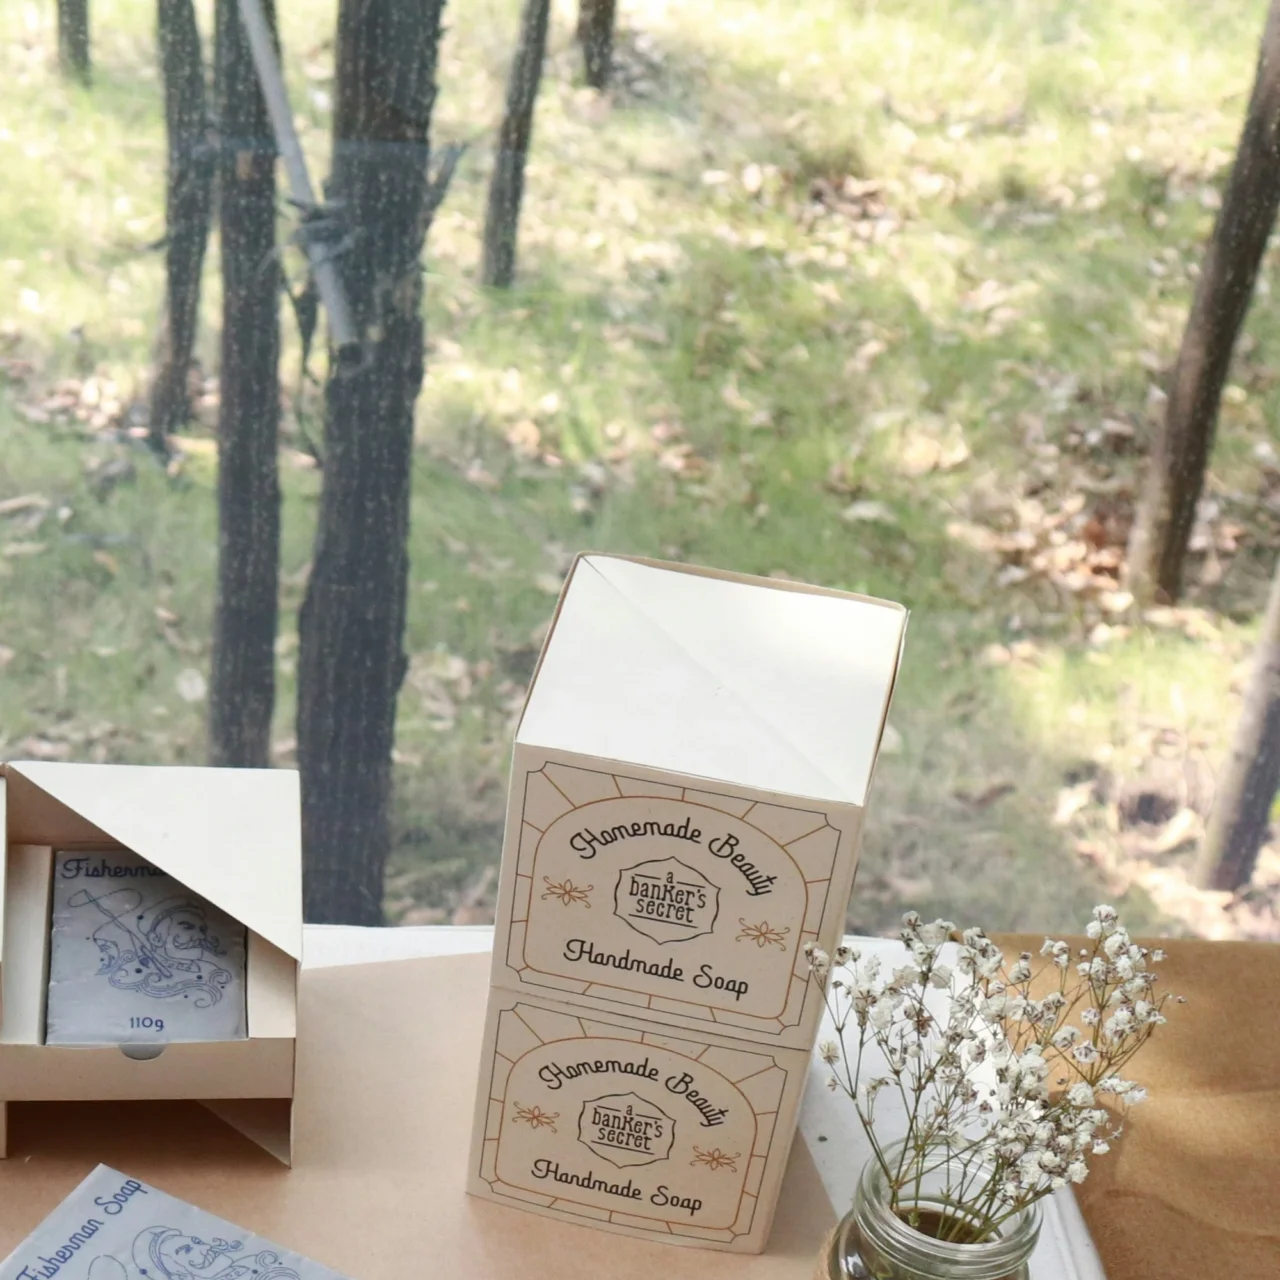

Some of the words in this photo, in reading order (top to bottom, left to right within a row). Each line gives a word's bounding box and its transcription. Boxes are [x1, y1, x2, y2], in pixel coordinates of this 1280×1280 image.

[61, 857, 167, 879] Fisherma
[569, 817, 703, 860] Homemade
[708, 833, 778, 897] Beauty
[666, 871, 674, 884] a
[635, 898, 695, 923] secret
[562, 938, 685, 982] Handmade
[692, 964, 749, 1001] Soap
[129, 1016, 165, 1033] 110g
[538, 1057, 659, 1090] Homemade
[665, 1072, 730, 1127] Beauty
[626, 1105, 633, 1116] a
[598, 1127, 652, 1150] secret
[94, 1178, 148, 1215] Soap
[530, 1159, 642, 1201] Handmade
[650, 1185, 703, 1216] Soap
